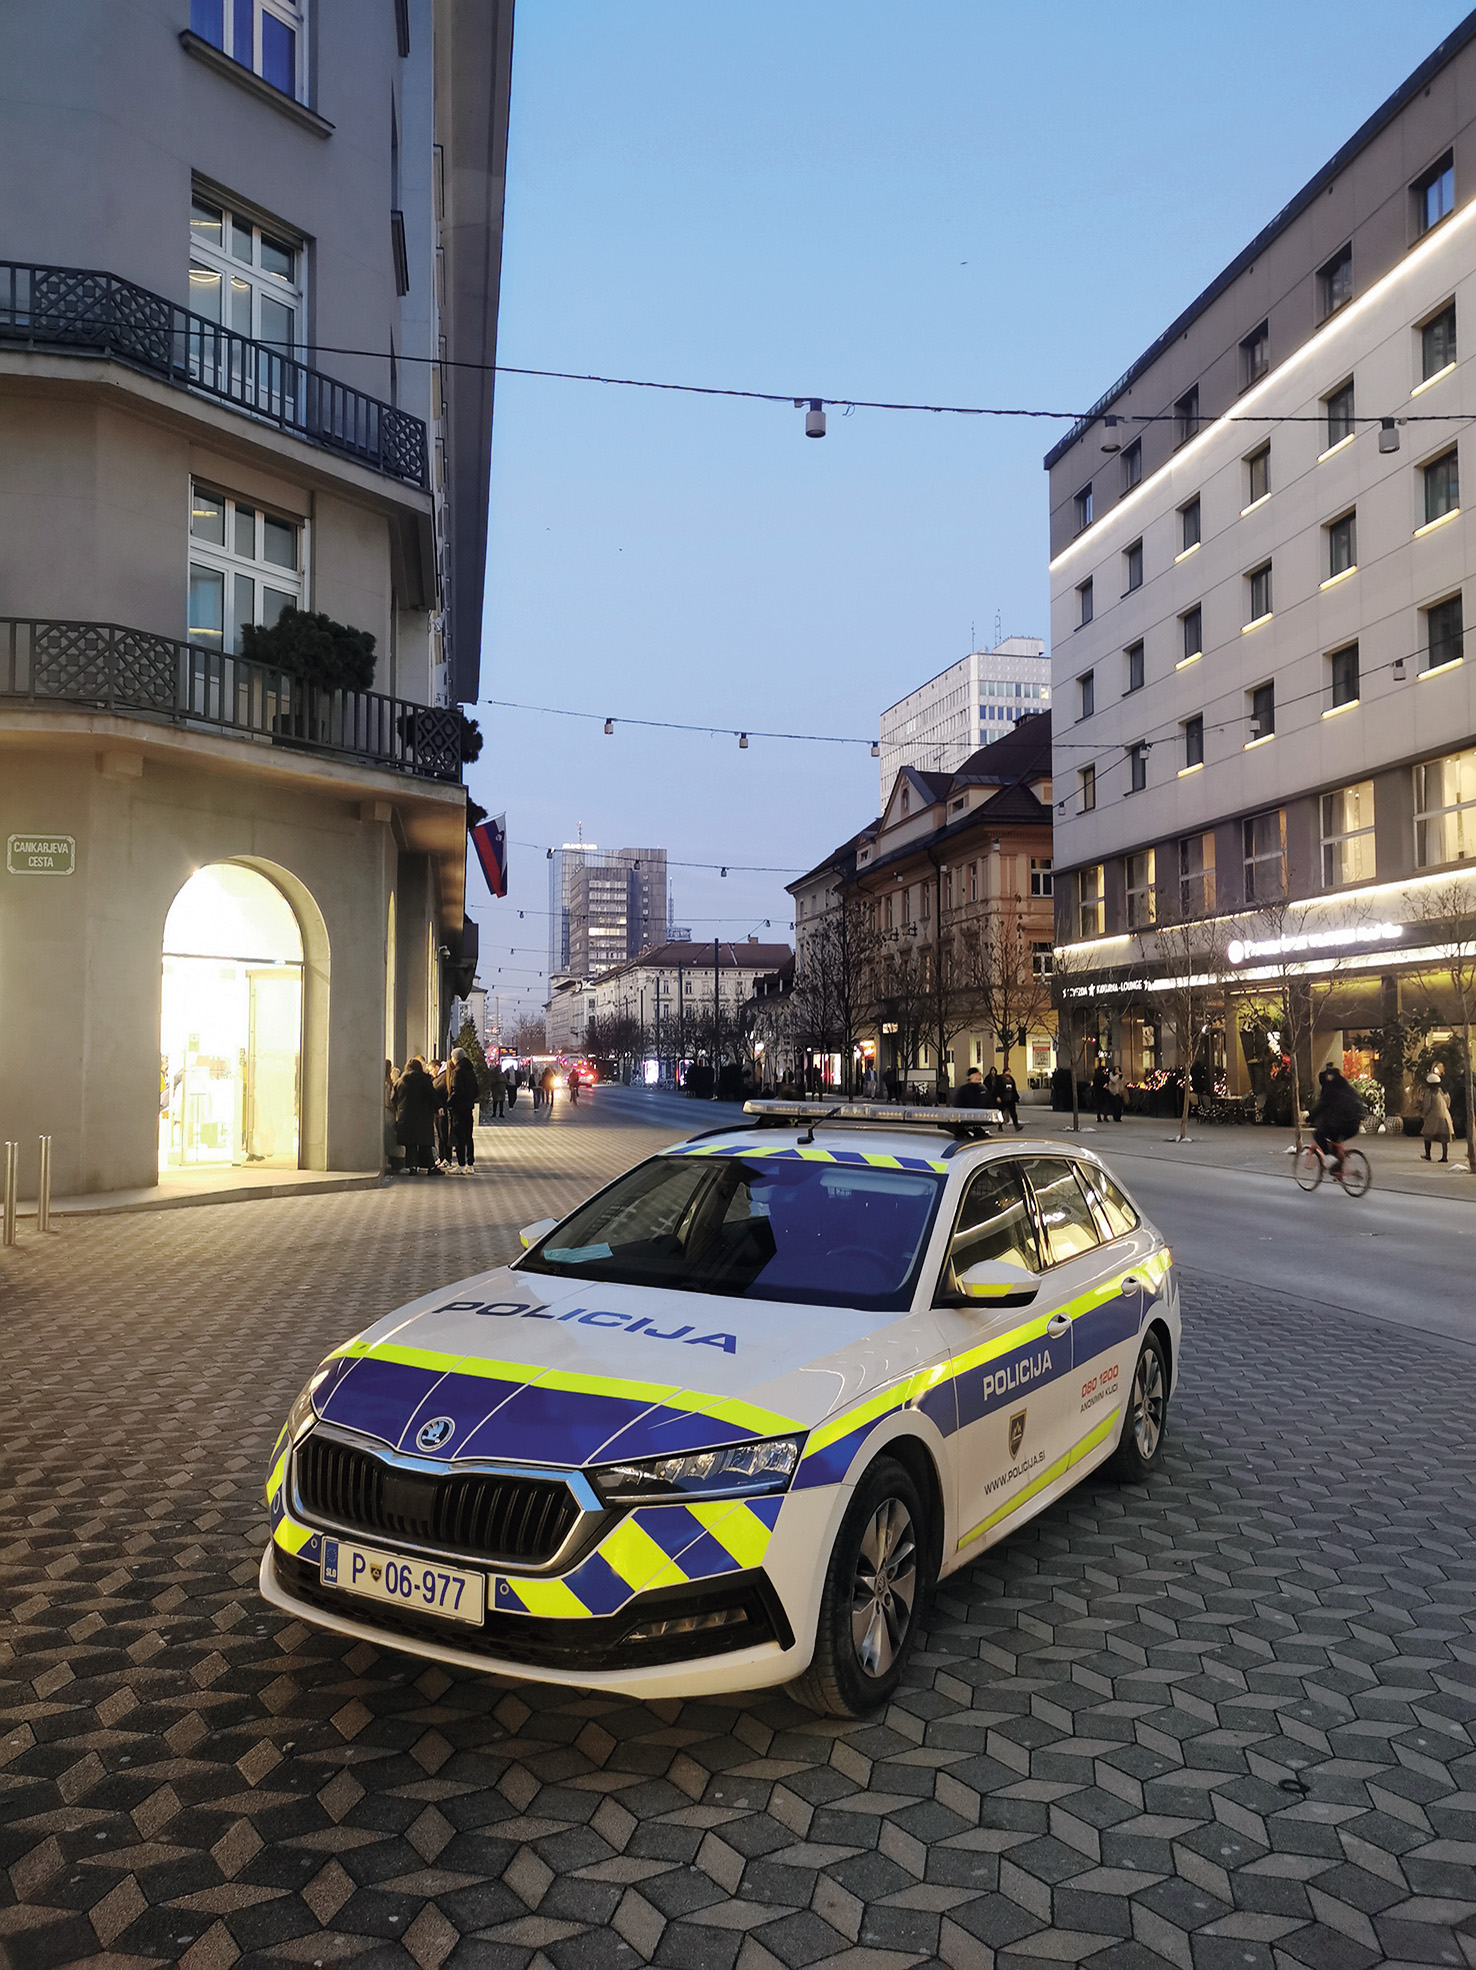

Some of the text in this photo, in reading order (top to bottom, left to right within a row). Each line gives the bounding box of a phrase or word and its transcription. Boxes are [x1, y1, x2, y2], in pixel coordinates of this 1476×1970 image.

[14, 841, 69, 854] CANKARJEVA
[28, 856, 54, 867] CESTA
[431, 1301, 737, 1355] POLICIJA
[982, 1349, 1053, 1401] POLICIJA
[1081, 1364, 1119, 1398] 080 1200
[984, 1450, 1046, 1495] WWW.POLICIJA.SI
[325, 1567, 337, 1578] SLO
[352, 1552, 466, 1610] P 06-977
